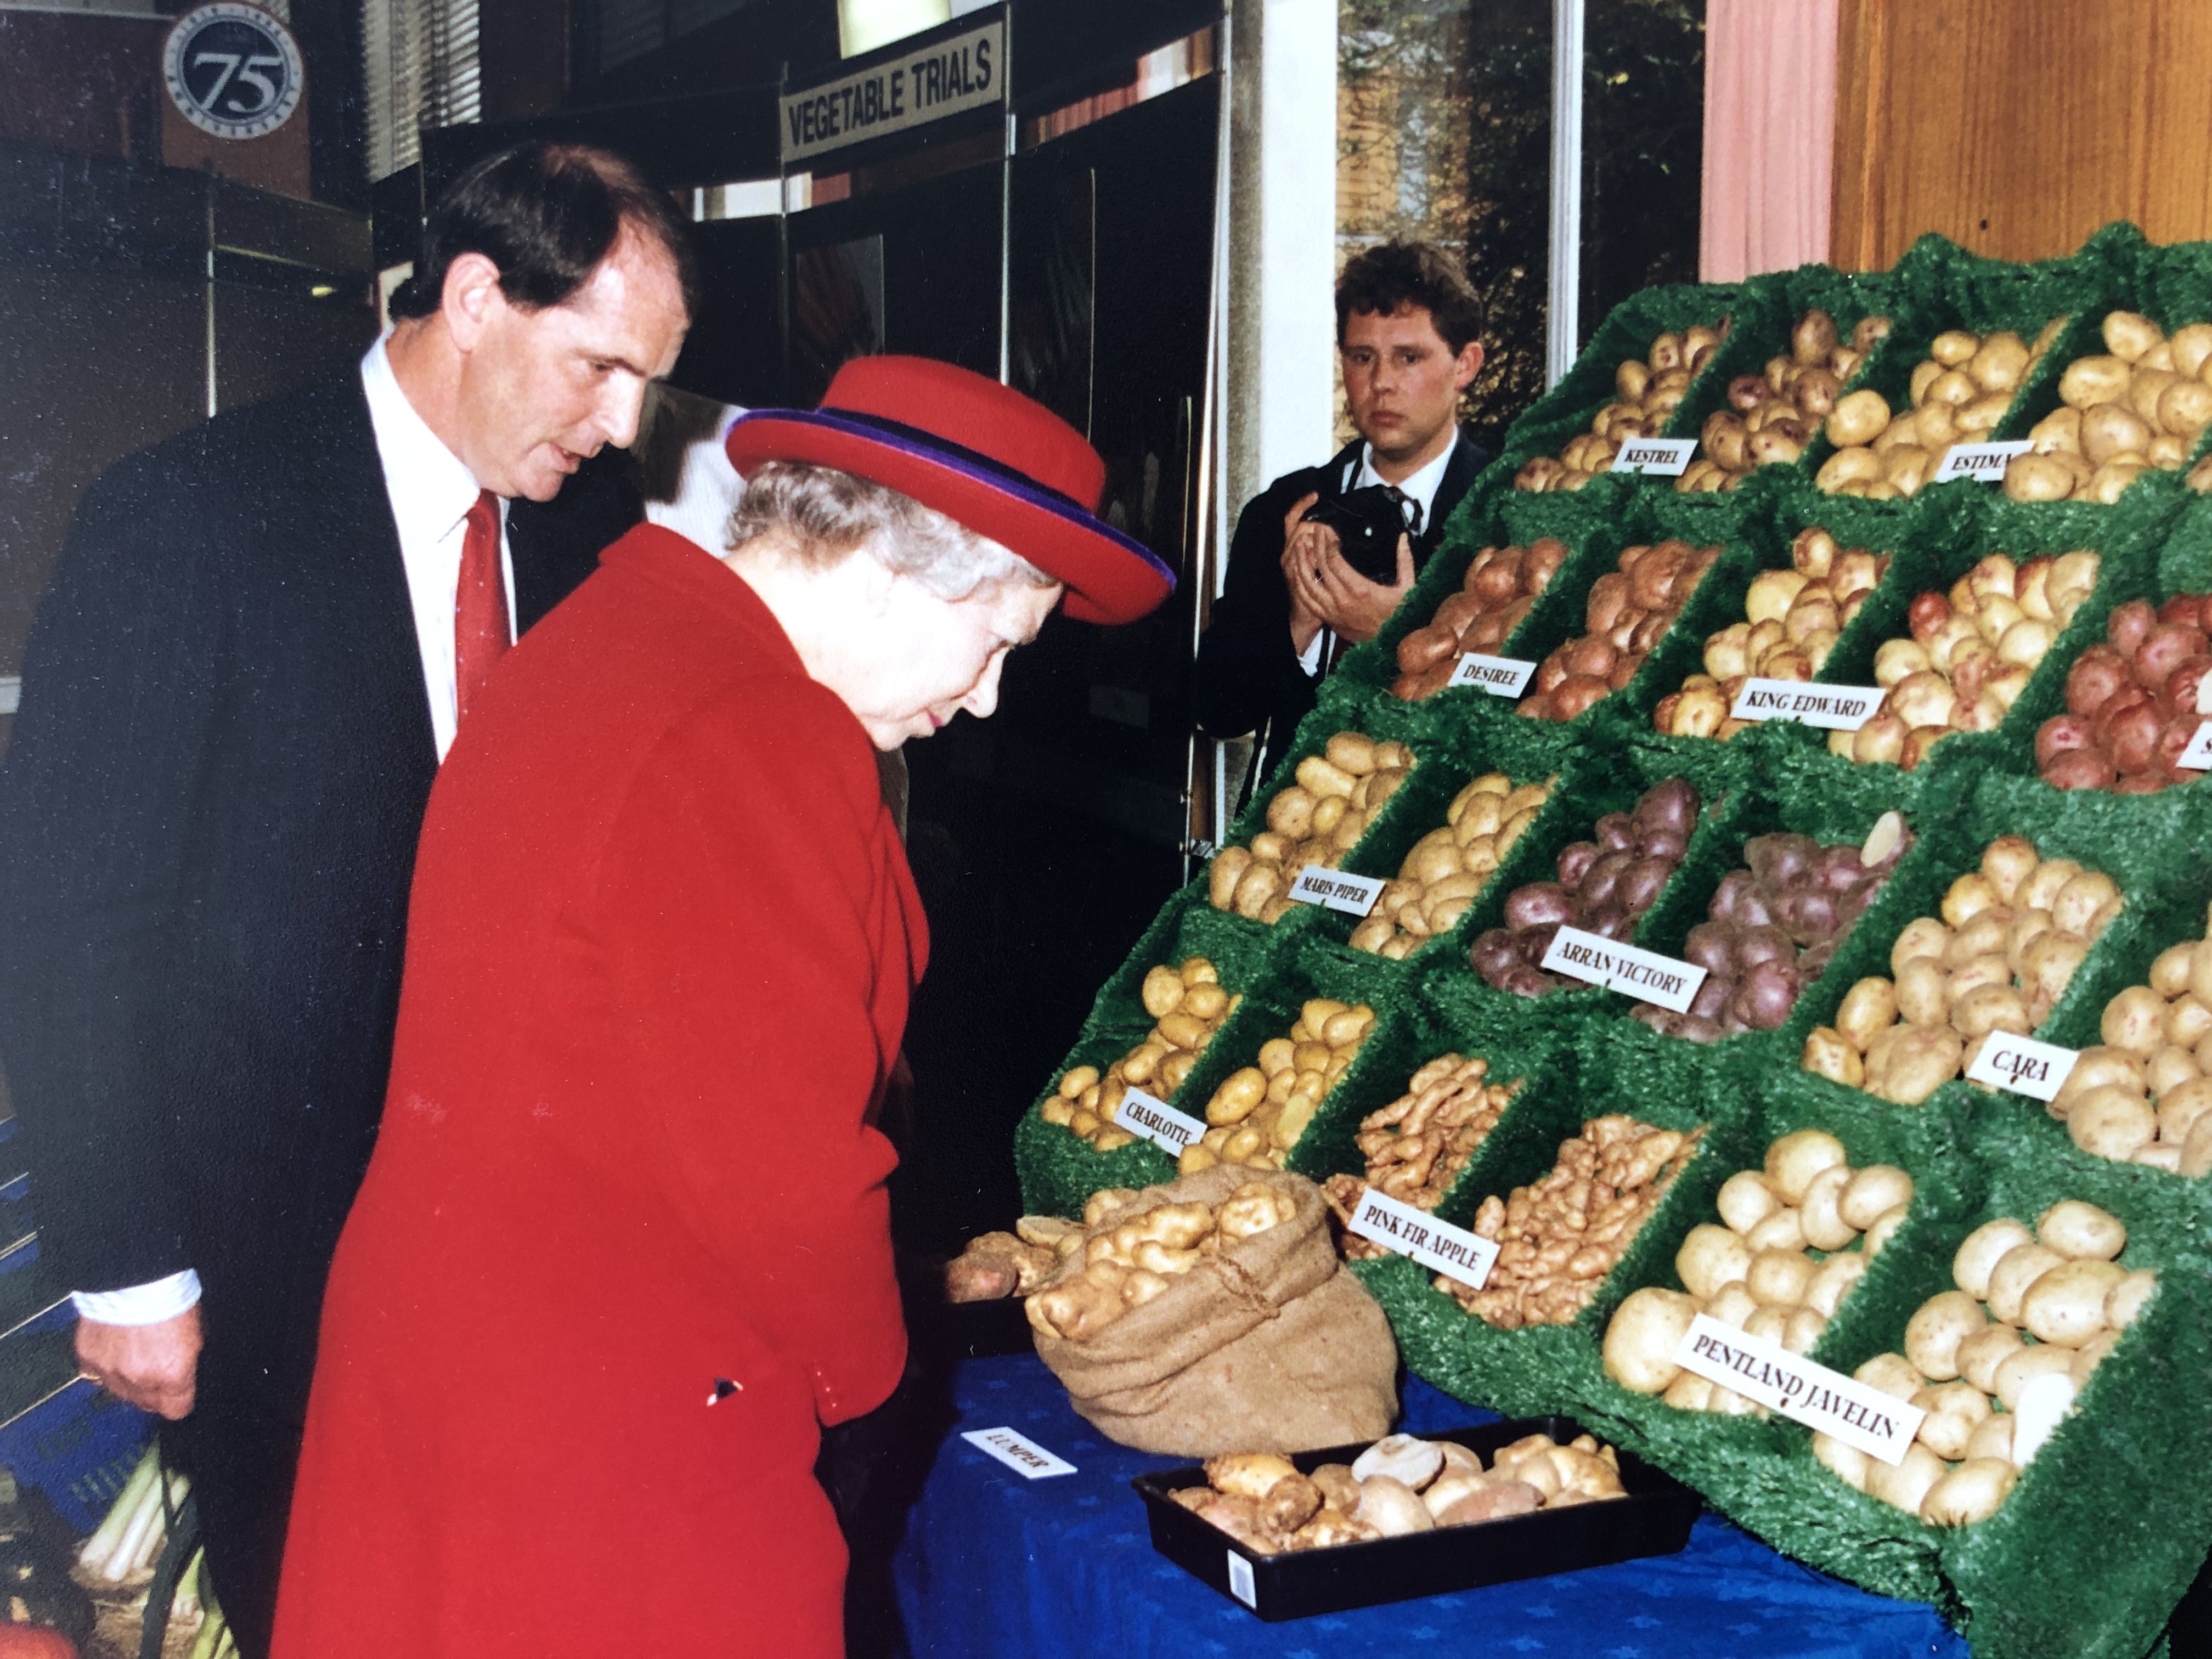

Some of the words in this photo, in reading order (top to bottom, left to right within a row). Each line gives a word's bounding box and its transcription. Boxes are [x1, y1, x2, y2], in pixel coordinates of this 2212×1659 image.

[194, 52, 284, 113] 75
[788, 70, 904, 147] VEGETABLE
[911, 38, 992, 110] TRIALS
[1624, 449, 1679, 464] KESTREL
[1463, 664, 1520, 686] DESIREE
[1746, 690, 1790, 709] KING
[1791, 695, 1867, 717] EDWARD
[1300, 876, 1335, 895] MARIS
[1333, 883, 1369, 904] PIPER
[1556, 941, 1615, 971] ARRAN
[1616, 958, 1688, 995] VICTORY
[1991, 1049, 2049, 1082] CARA
[1126, 1102, 1193, 1146] CHARLOTTE
[1364, 1205, 1403, 1235] PINK
[1401, 1221, 1430, 1249] FIR
[1427, 1234, 1482, 1271] APPLE
[1691, 1334, 1805, 1397] PENTLAND
[1798, 1385, 1900, 1440] JAVELIN
